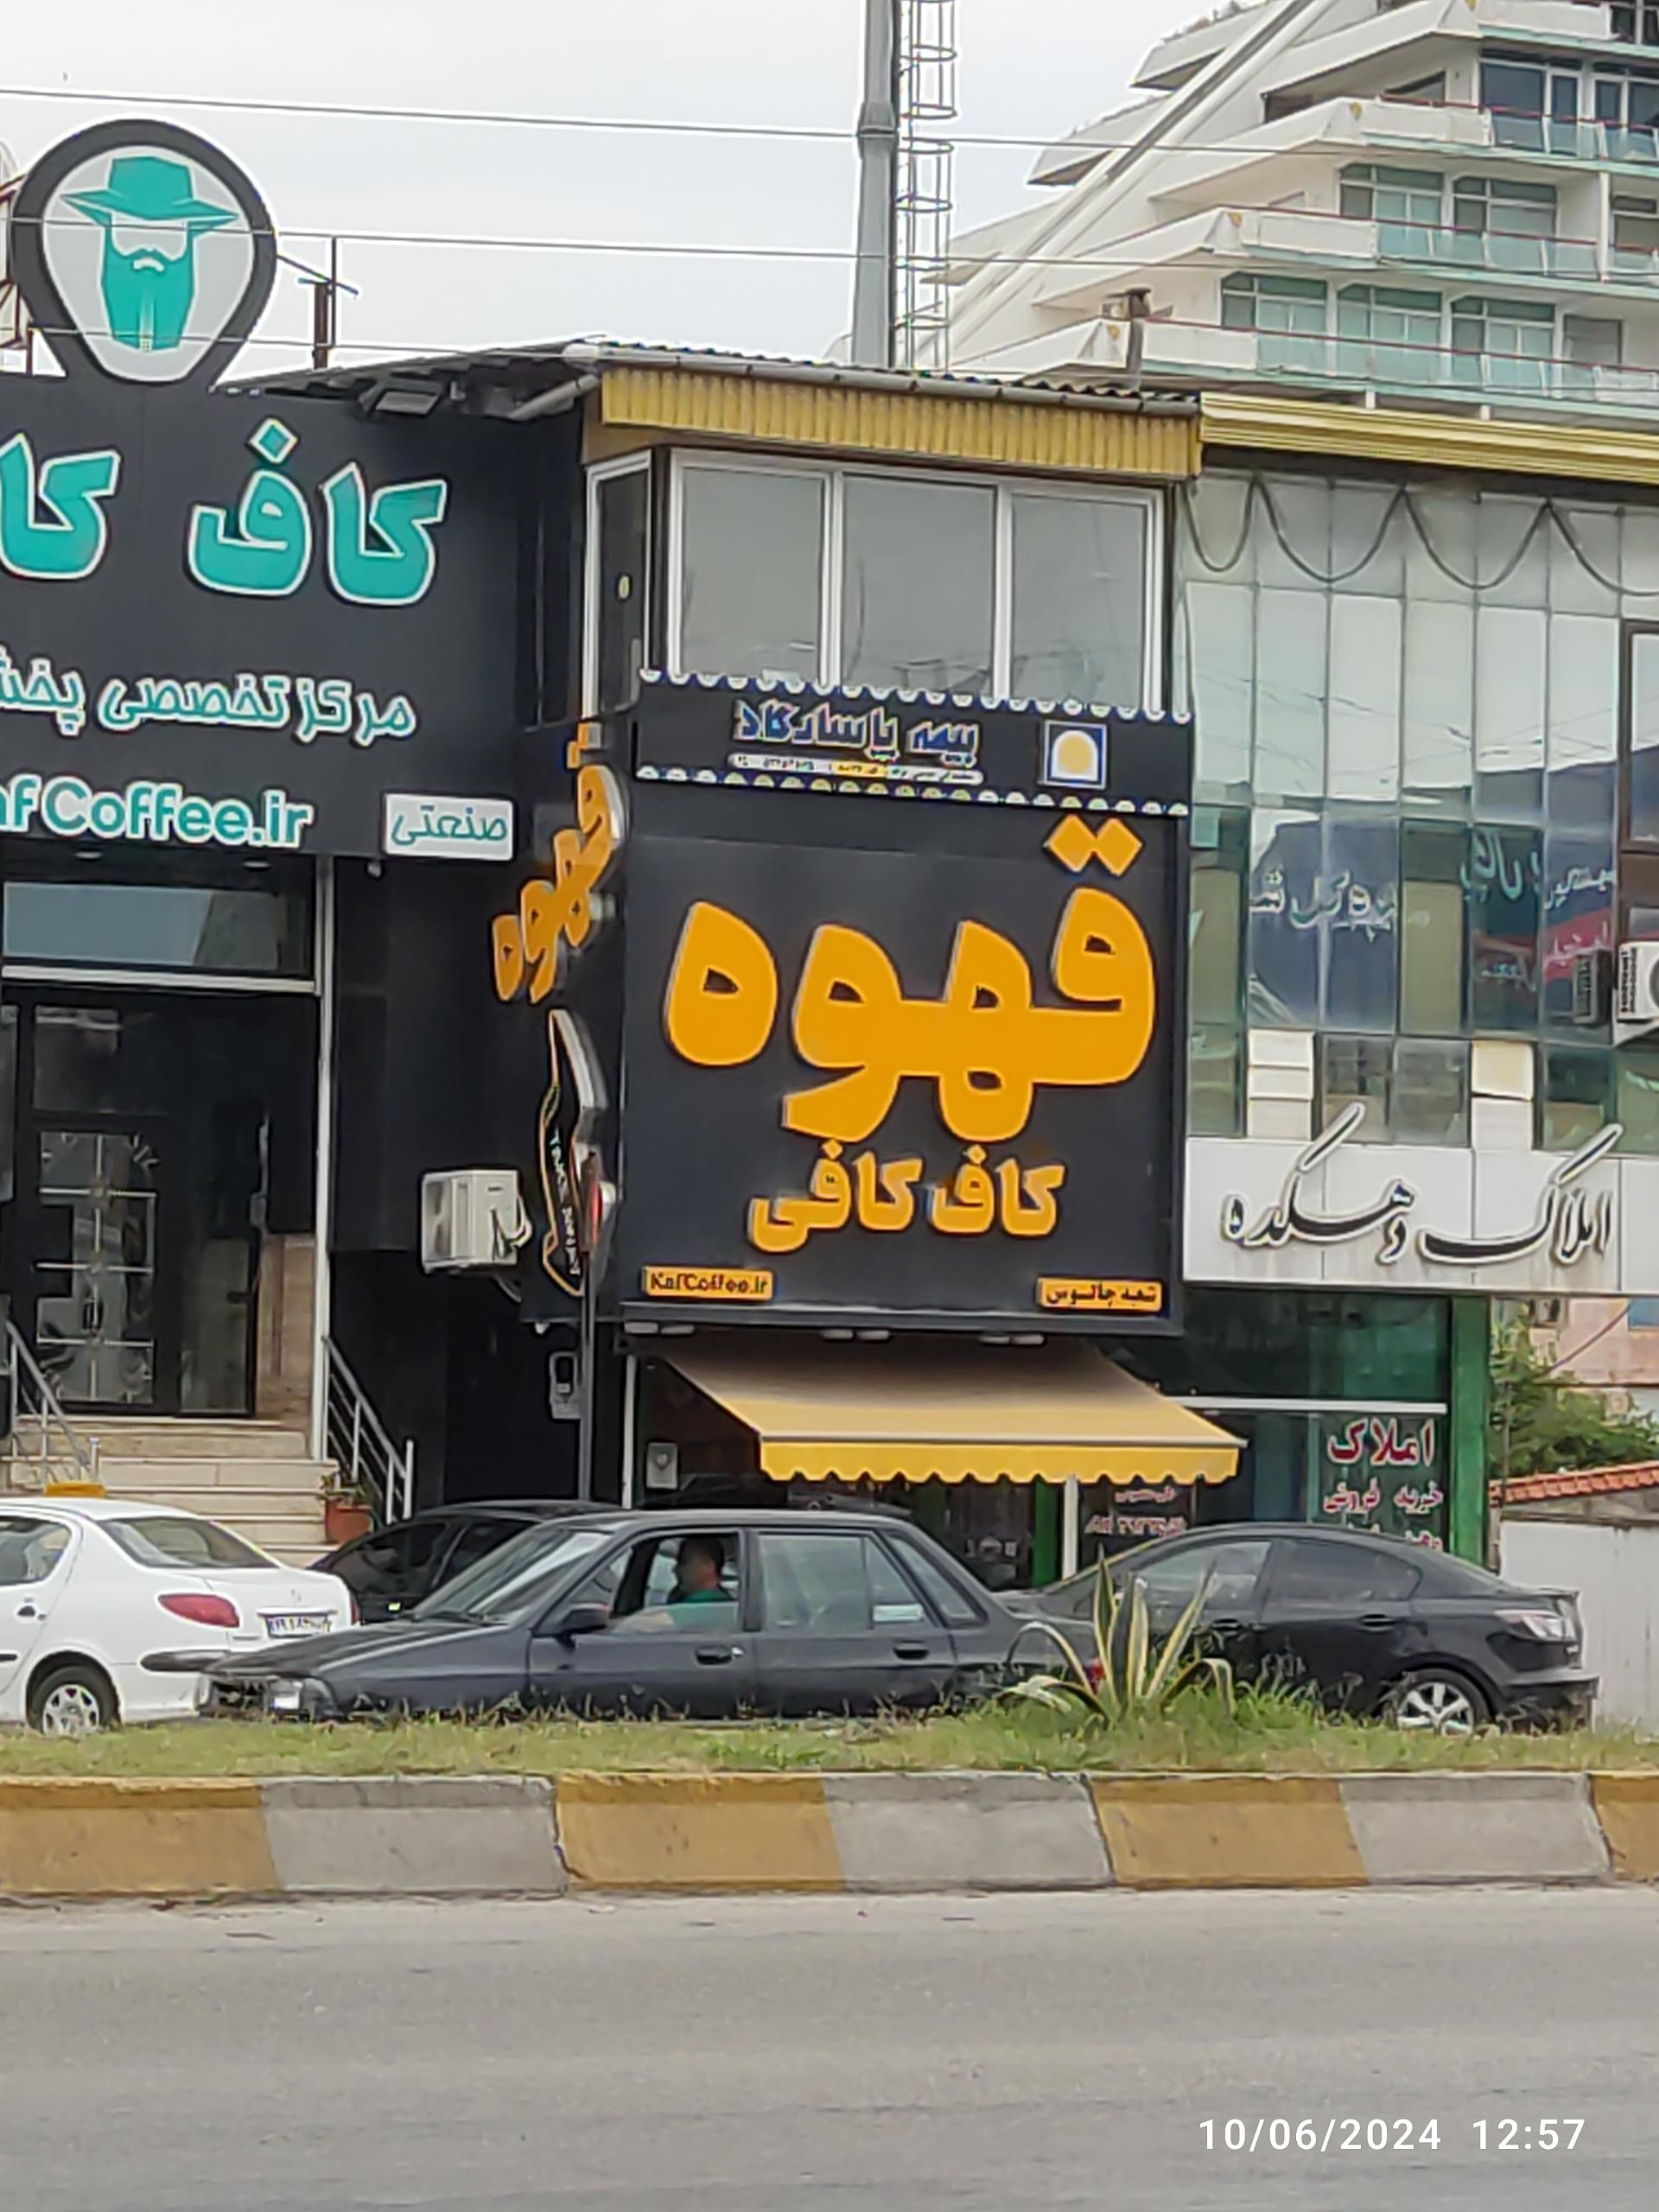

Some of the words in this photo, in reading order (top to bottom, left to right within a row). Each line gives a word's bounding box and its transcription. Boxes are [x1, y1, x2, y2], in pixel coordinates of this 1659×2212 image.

[185, 416, 448, 607] کاف
[98, 672, 291, 732] تخصصی
[294, 677, 416, 746] مرکز
[0, 773, 314, 849] fCoffee.ir
[391, 804, 509, 847] صنعتی
[492, 721, 626, 1004] قهوه
[665, 814, 1156, 1143] قهوه
[747, 1138, 923, 1254] کافی
[928, 1142, 1066, 1236] کاف
[1327, 1416, 1436, 1468] املاک
